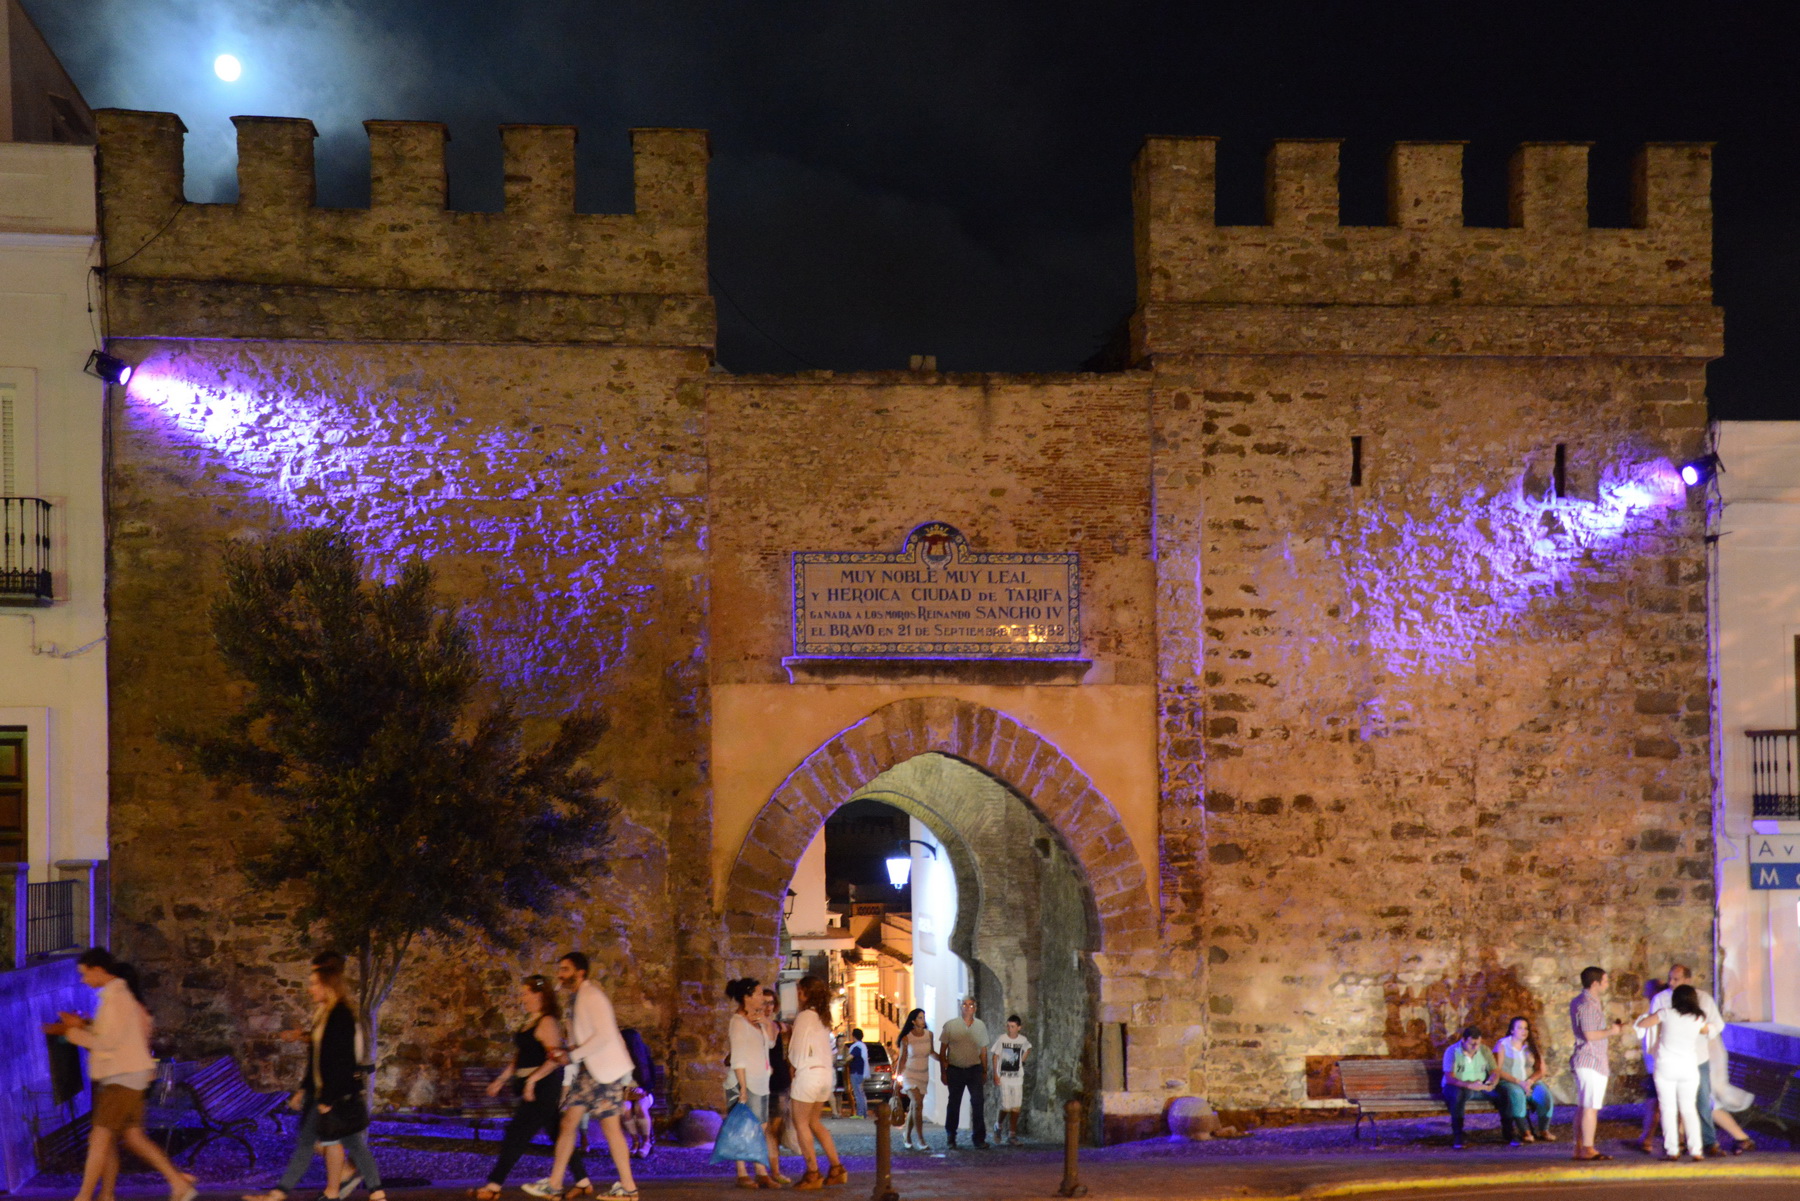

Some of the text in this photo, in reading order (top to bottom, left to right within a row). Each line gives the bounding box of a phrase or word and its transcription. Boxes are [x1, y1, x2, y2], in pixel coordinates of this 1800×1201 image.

[841, 570, 1032, 584] MUY NOBLE MUY LEAL
[827, 588, 901, 603] HEROICA
[911, 588, 972, 601] CIUDAD
[1005, 588, 1062, 603] TARIFA
[809, 610, 852, 619] GANADA
[855, 611, 862, 619] A
[864, 610, 883, 619] LOS
[975, 606, 1041, 619] SANCHO
[1046, 606, 1063, 619] IV
[829, 624, 875, 638] BRAVO
[897, 624, 911, 636] 21
